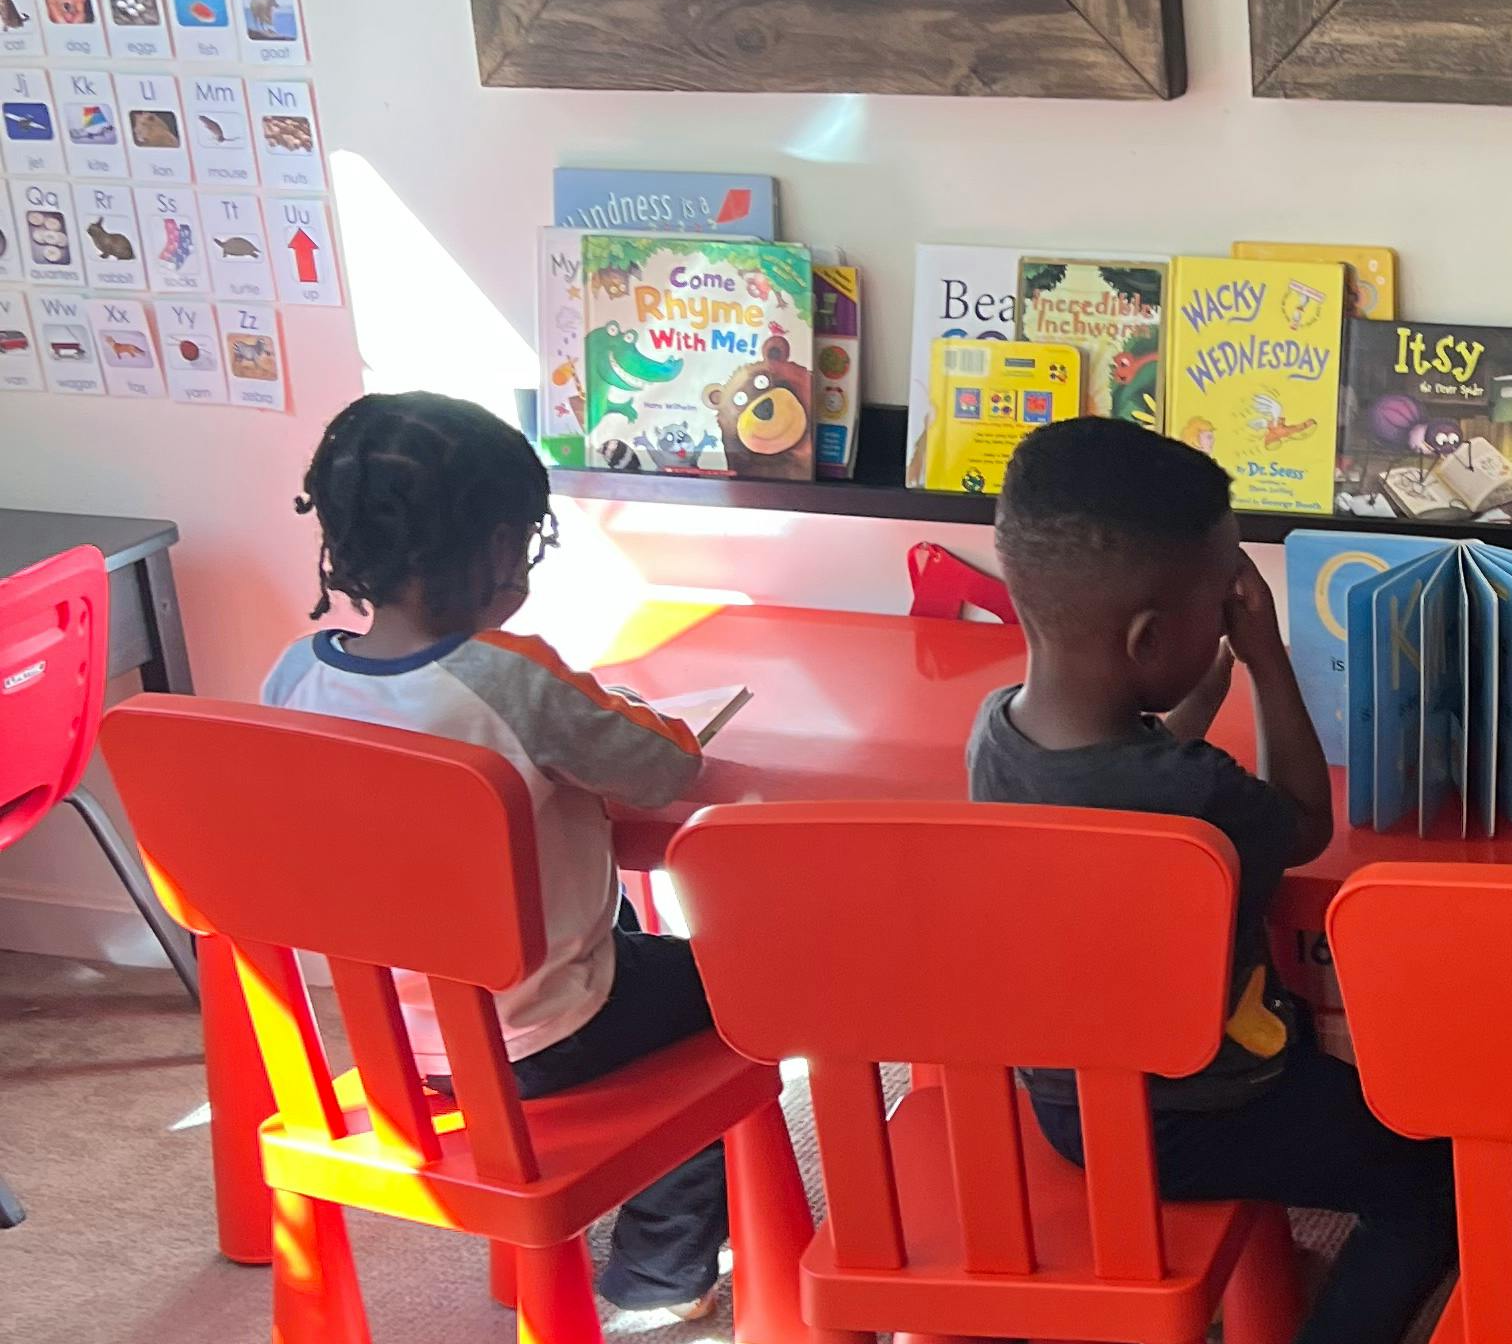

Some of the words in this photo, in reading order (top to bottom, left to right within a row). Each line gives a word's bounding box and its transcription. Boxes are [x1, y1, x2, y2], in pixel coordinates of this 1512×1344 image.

[195, 82, 235, 102] Mm
[268, 87, 296, 107] Nn
[669, 266, 736, 292] Come
[634, 285, 764, 330] Rhyme
[1032, 288, 1154, 319] Incredible
[1181, 280, 1267, 333] WACKY
[1037, 310, 1150, 341] Inchworm
[649, 328, 706, 352] With
[711, 329, 758, 357] Me!
[1394, 327, 1485, 382] Itsy
[1186, 333, 1331, 393] WEDNESDAY
